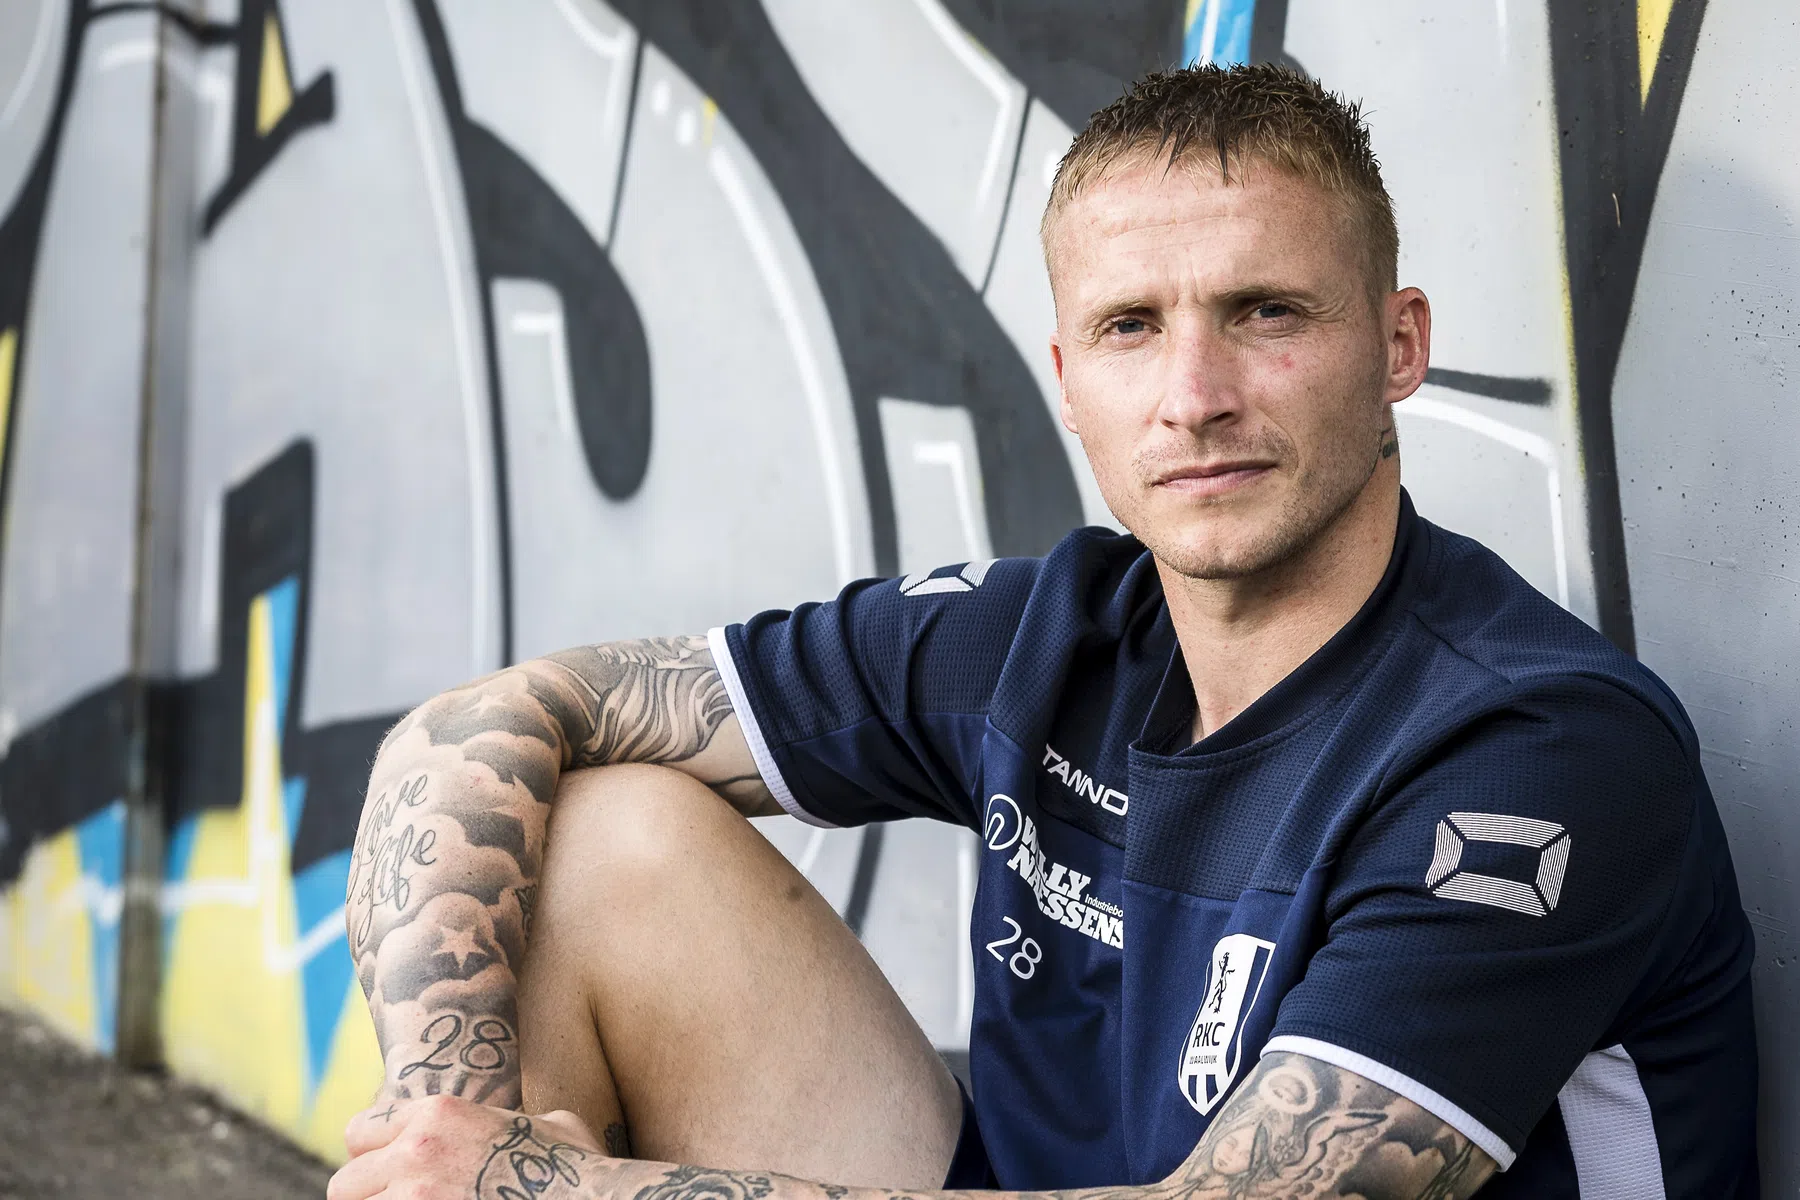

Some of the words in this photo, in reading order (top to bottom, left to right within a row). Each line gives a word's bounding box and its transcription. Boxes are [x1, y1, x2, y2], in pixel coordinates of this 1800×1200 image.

[986, 916, 1042, 979] 28
[398, 1014, 513, 1081] 28
[1192, 1022, 1225, 1048] RKC
